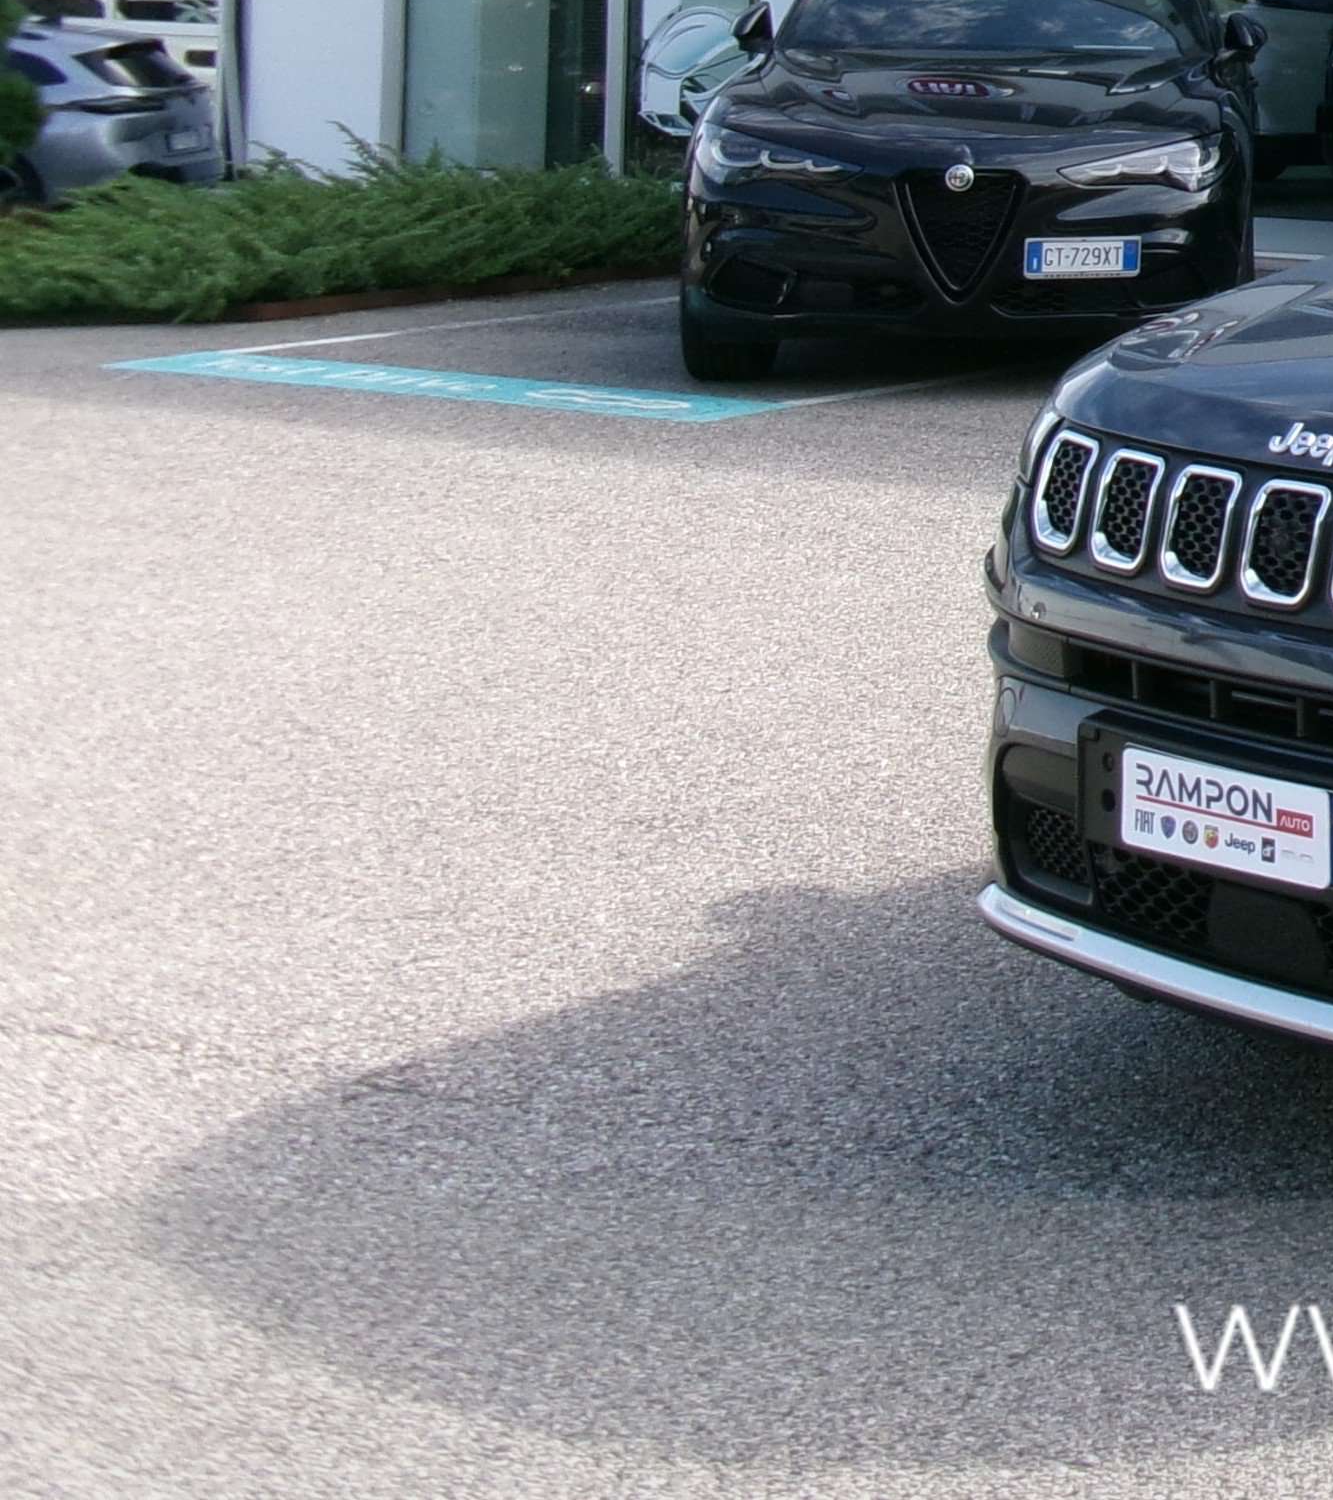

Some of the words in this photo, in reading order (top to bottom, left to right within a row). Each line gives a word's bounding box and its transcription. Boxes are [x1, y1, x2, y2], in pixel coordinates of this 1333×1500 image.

[1135, 762, 1273, 823] RAMPON
[1279, 815, 1310, 832] AUTO
[1134, 809, 1156, 835] FIAT
[1224, 833, 1256, 856] Jeep
